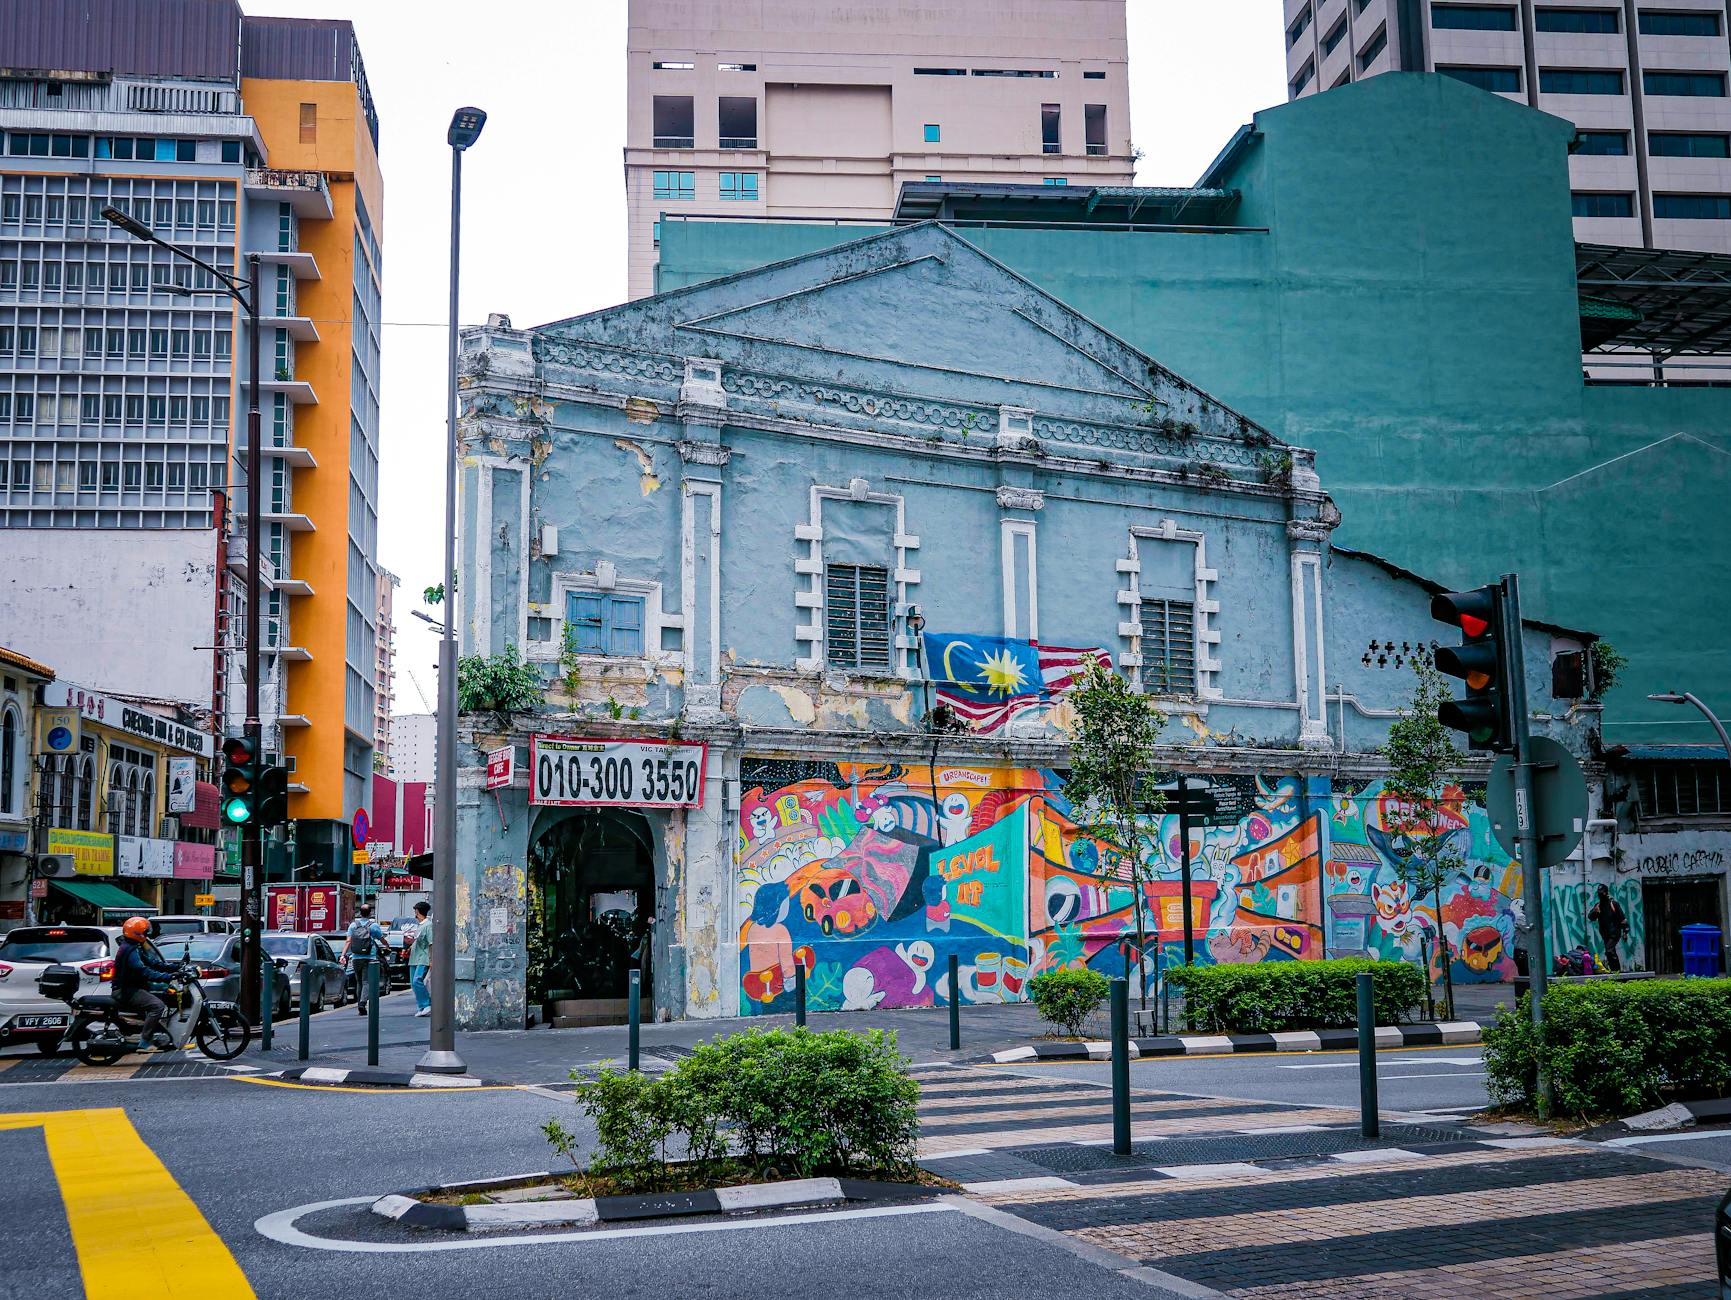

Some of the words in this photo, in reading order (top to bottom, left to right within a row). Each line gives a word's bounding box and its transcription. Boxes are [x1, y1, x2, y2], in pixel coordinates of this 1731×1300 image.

[539, 754, 632, 799] 010-300
[641, 758, 698, 801] 3550
[937, 843, 1000, 881] LEVEL
[957, 879, 984, 907] UP
[25, 1017, 39, 1026] VFY
